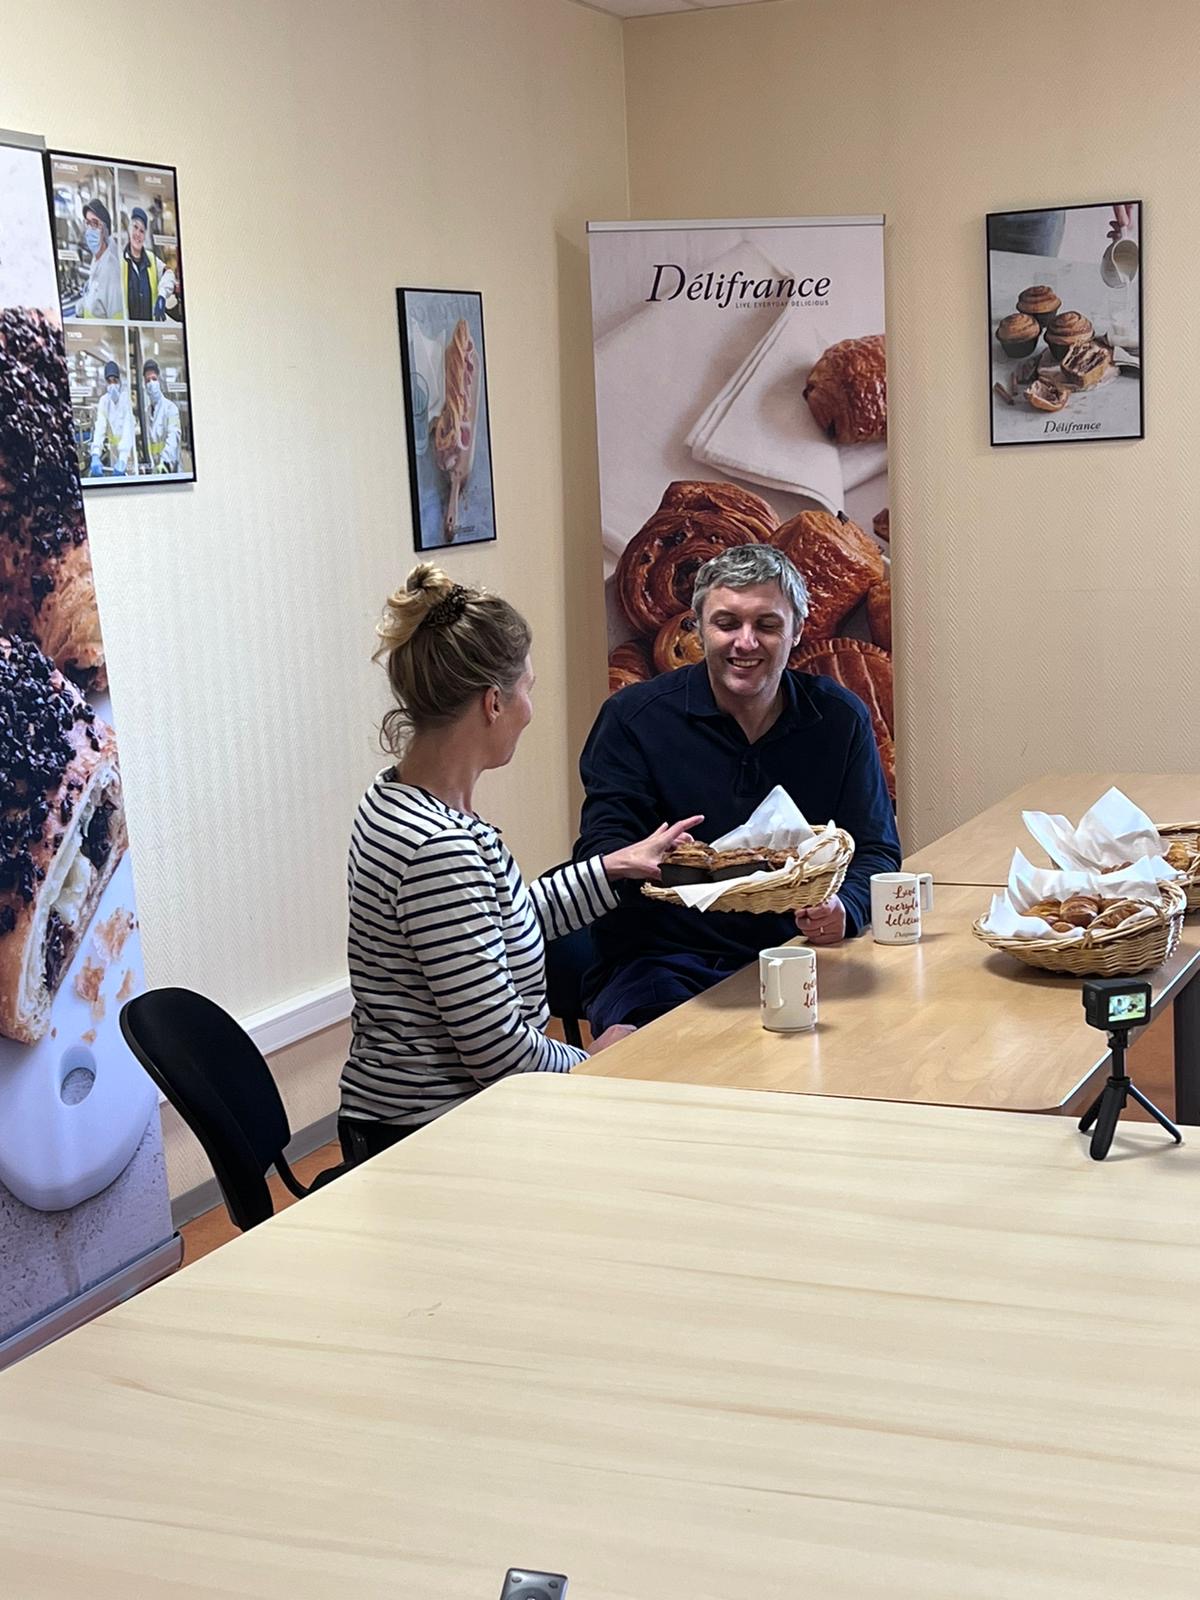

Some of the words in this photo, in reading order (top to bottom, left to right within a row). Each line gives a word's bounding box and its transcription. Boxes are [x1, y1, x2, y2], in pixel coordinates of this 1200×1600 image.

[645, 264, 832, 309] Délifrance
[753, 301, 789, 309] EVERYDAY
[790, 300, 830, 308] DELICIOUS
[1043, 420, 1102, 434] Délifrance
